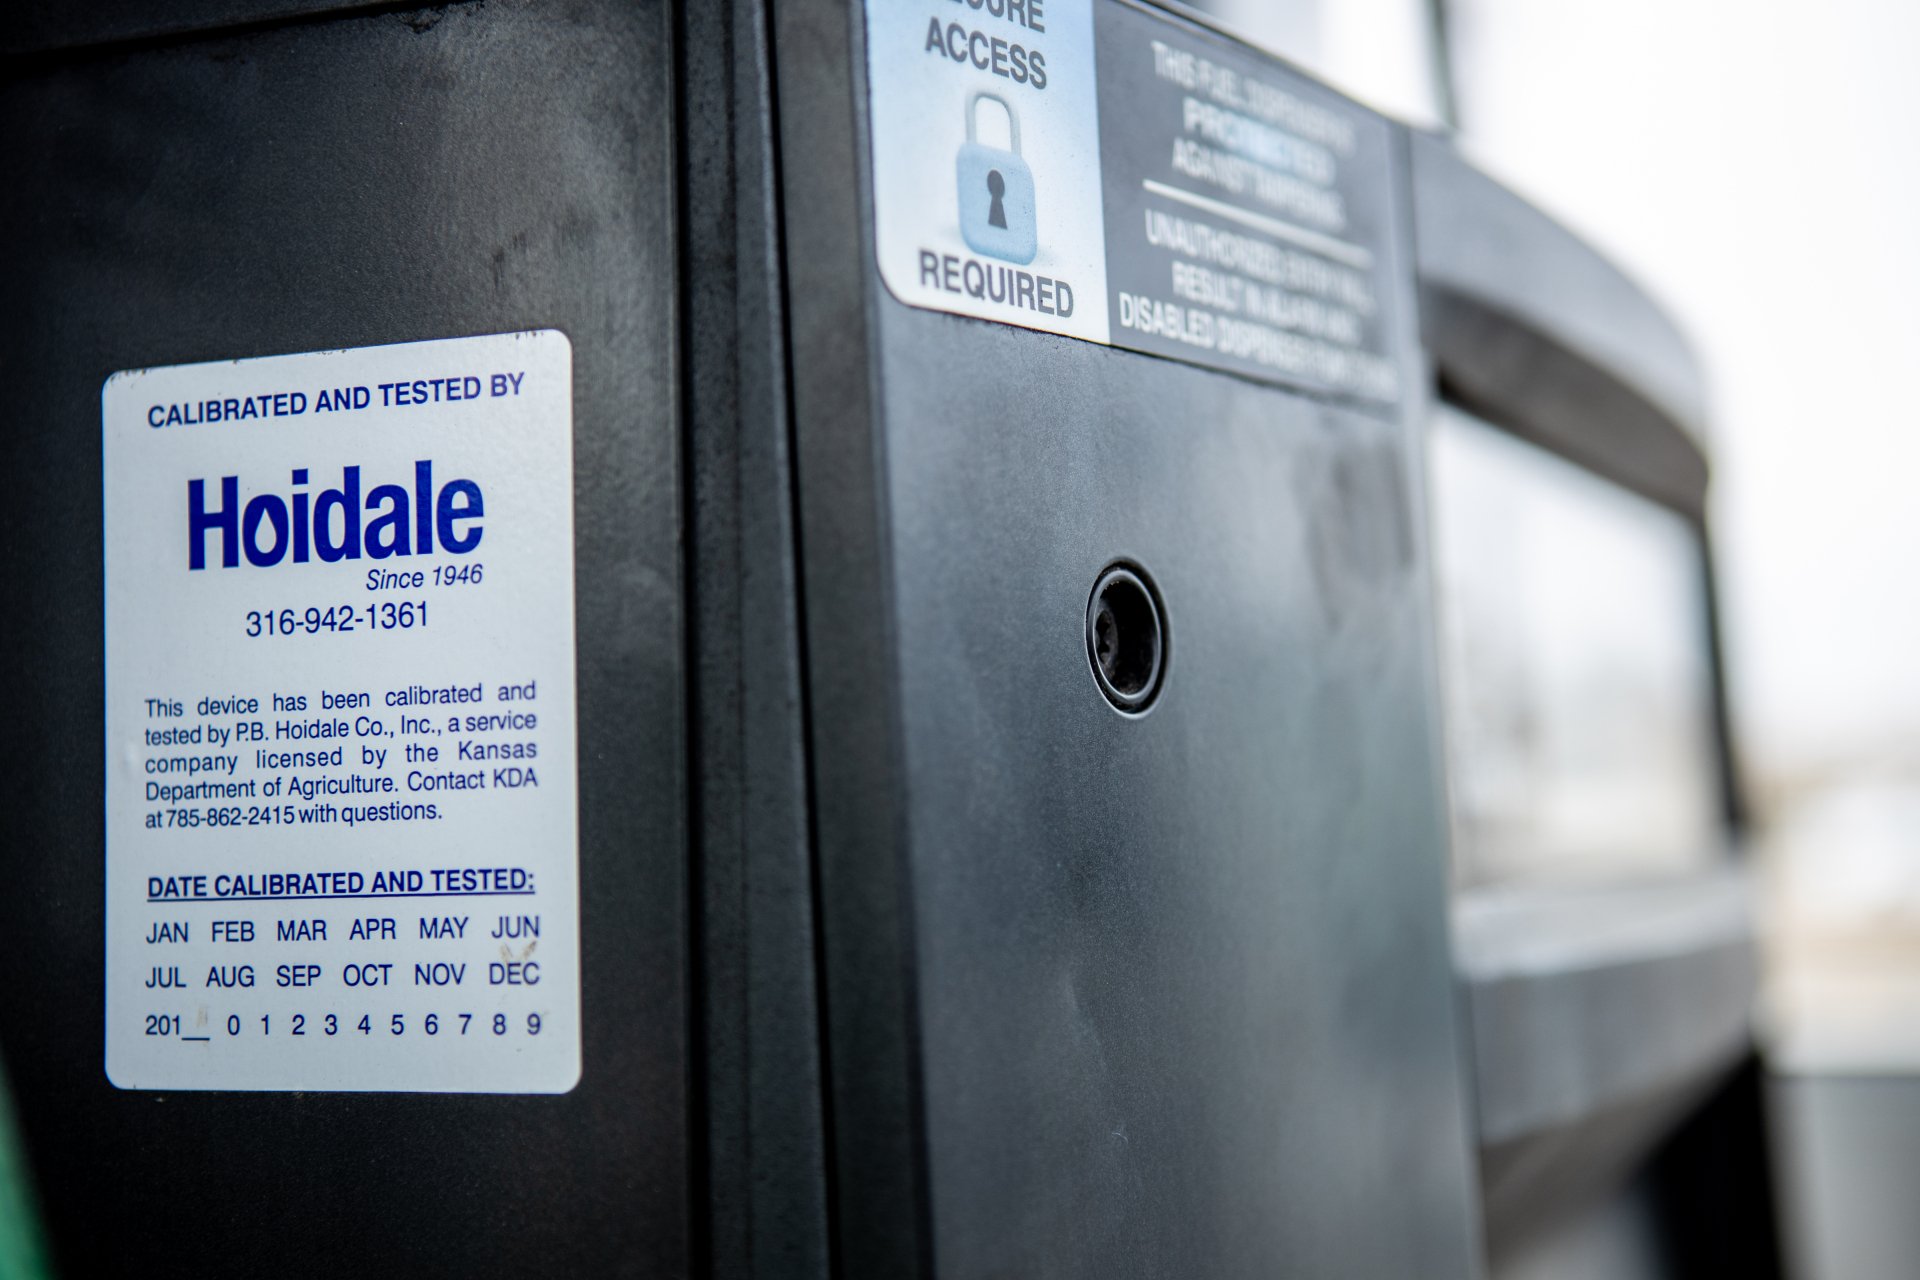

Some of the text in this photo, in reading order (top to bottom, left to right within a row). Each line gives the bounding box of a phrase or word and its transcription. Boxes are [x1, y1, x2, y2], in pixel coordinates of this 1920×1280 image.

[925, 16, 1047, 90] ACCESS
[918, 247, 1074, 319] REQUIRED
[1119, 291, 1215, 348] DISABLED
[148, 372, 524, 428] CALIBRATED AND TESTED BY
[188, 459, 484, 571] Hoidale
[366, 563, 483, 591] Since 1946
[246, 601, 426, 637] 316-942-1361
[145, 680, 536, 718] This device has been calibrated and
[145, 710, 537, 748] tested by P.B. Hoidale Co., Inc., a service
[145, 740, 537, 776] company licensed by the Kansas
[146, 768, 538, 805] Department of Agriculture. Contact KDA
[146, 801, 442, 829] at 785-862-2415 with questions.
[147, 868, 533, 898] DATE CALIBRATED AND TESTED:
[146, 916, 539, 944] JAN FEB MAR APR MAY JUN
[145, 962, 540, 988] JUL AUG SEP OCT NOV DEC
[228, 1015, 240, 1036] 0
[261, 1014, 269, 1035] 1
[292, 1014, 305, 1035] 2
[325, 1014, 338, 1035] 3
[358, 1014, 371, 1035] 4
[391, 1014, 404, 1035] 5
[425, 1013, 438, 1035] 6
[458, 1014, 472, 1035] 7
[493, 1013, 506, 1035] 8
[527, 1013, 541, 1035] 9
